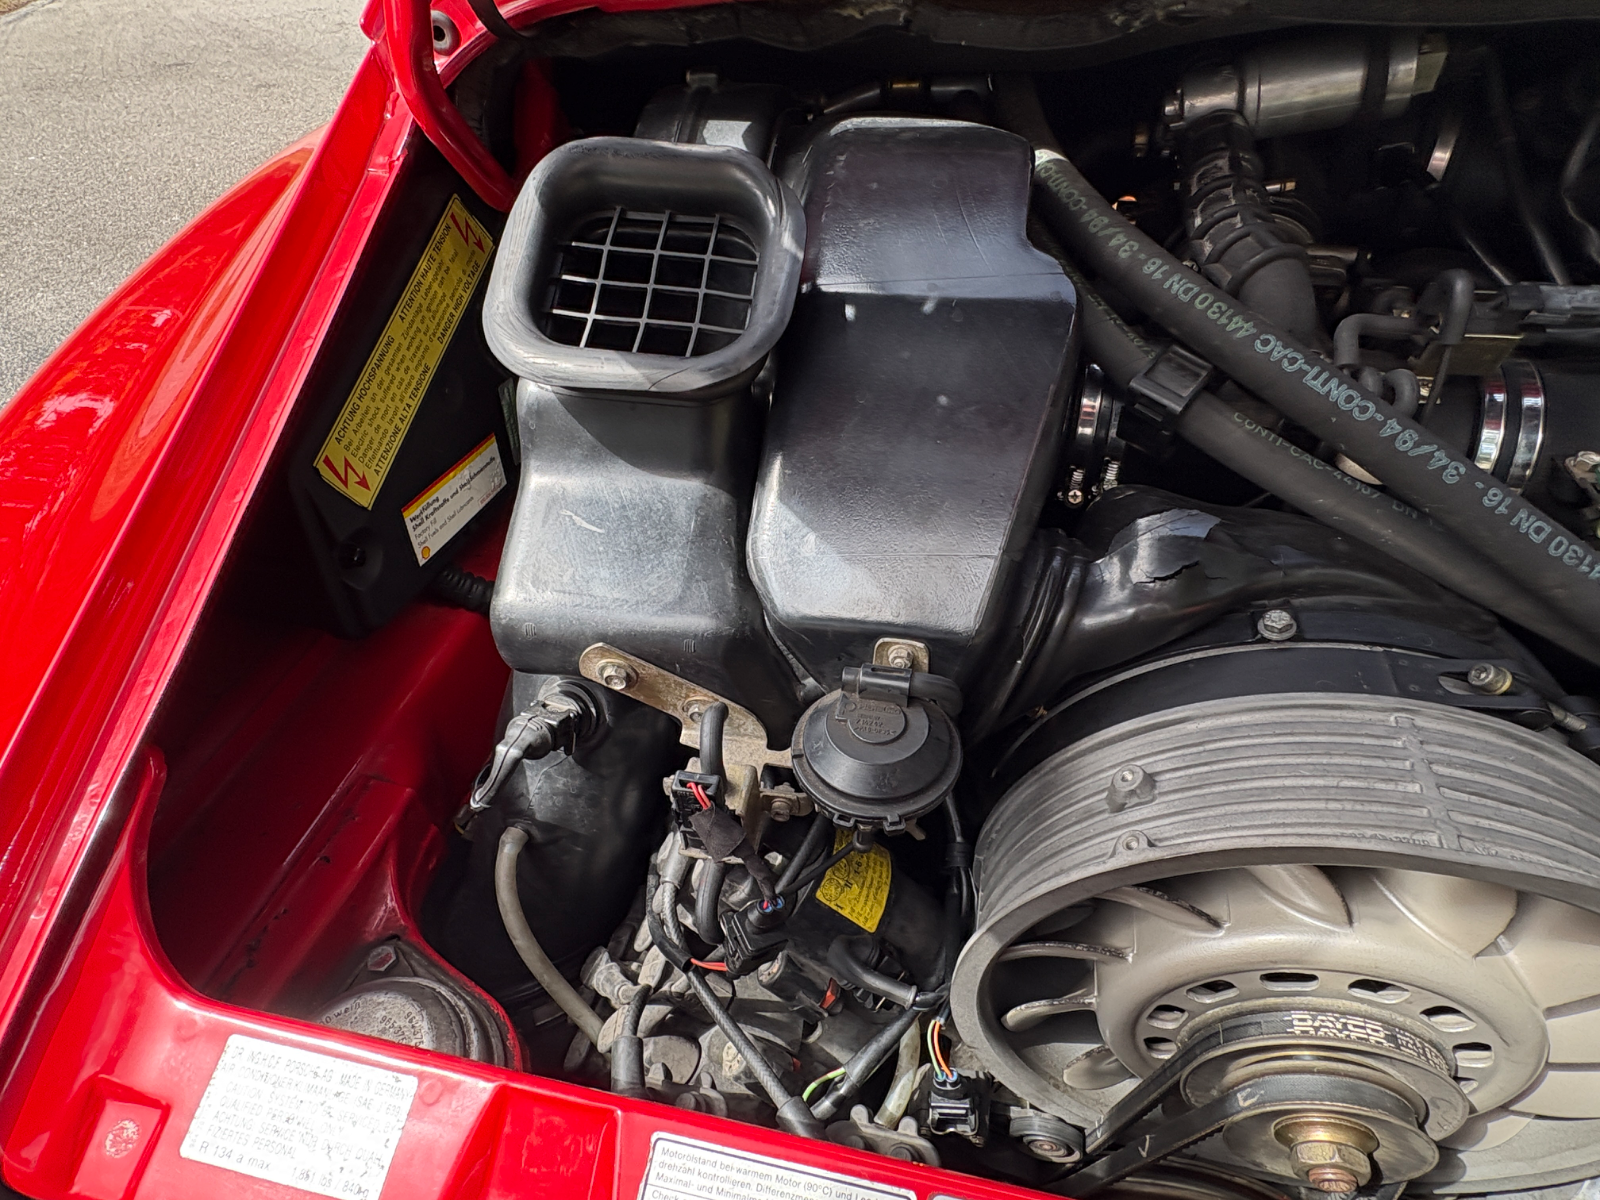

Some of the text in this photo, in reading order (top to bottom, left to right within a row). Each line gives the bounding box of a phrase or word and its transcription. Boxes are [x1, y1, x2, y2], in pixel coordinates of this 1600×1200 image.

[398, 222, 451, 323] ATTENTION HAUTE TENSION
[1163, 273, 1200, 302] DN
[437, 259, 480, 344] DANGER HIGH VOLTAGE
[351, 249, 458, 458] Electric shock suffered when working on ignition can be fatal
[334, 334, 394, 445] ACHTUNG HOCHSPANNUNG
[344, 437, 352, 451] Bei
[352, 404, 370, 436] Arbeiten
[370, 392, 376, 402] an
[376, 376, 384, 390] der
[384, 341, 403, 375] gesamten
[358, 435, 375, 464] Danger
[373, 423, 380, 434] de
[380, 404, 390, 421] mort
[390, 392, 396, 402] en
[396, 376, 404, 389] cas
[403, 364, 410, 374] de
[409, 338, 423, 362] travaux
[422, 323, 430, 336] sur
[365, 427, 389, 469] Effettuando
[387, 405, 399, 425] lavori
[398, 374, 414, 404] all'intero
[414, 344, 430, 373] impianto
[372, 362, 431, 475] ATTENZIONE ALTA TENSIONE
[449, 487, 459, 498] und
[1482, 488, 1512, 514] 16
[414, 524, 430, 540] Factory
[438, 519, 447, 529] and
[446, 510, 457, 522] Shell
[1510, 508, 1552, 544] DN
[1291, 1014, 1385, 1038] DAYCO
[220, 1061, 236, 1073] AIR
[282, 1058, 320, 1079] PORSCHE
[320, 1068, 334, 1082] AG
[338, 1072, 361, 1089] MADE
[361, 1078, 372, 1091] IN
[219, 1096, 263, 1116] QUALIFIED
[319, 1121, 344, 1137] ONLY
[305, 1101, 319, 1114] TO
[205, 1124, 298, 1158] FIZIERTES PERSONAL
[258, 1121, 296, 1141] SERVICE
[198, 1140, 210, 1153] R
[213, 1145, 233, 1159] 134
[235, 1153, 244, 1163] a
[656, 1172, 694, 1187] Maximal-
[697, 1182, 713, 1194] und
[658, 1160, 695, 1176] drehzahl
[698, 1170, 753, 1190] kontrollieren.
[661, 1147, 717, 1168] Motorölstand
[736, 1167, 773, 1181] warmem
[775, 1174, 801, 1188] Motor
[803, 1182, 833, 1198] (90°C)
